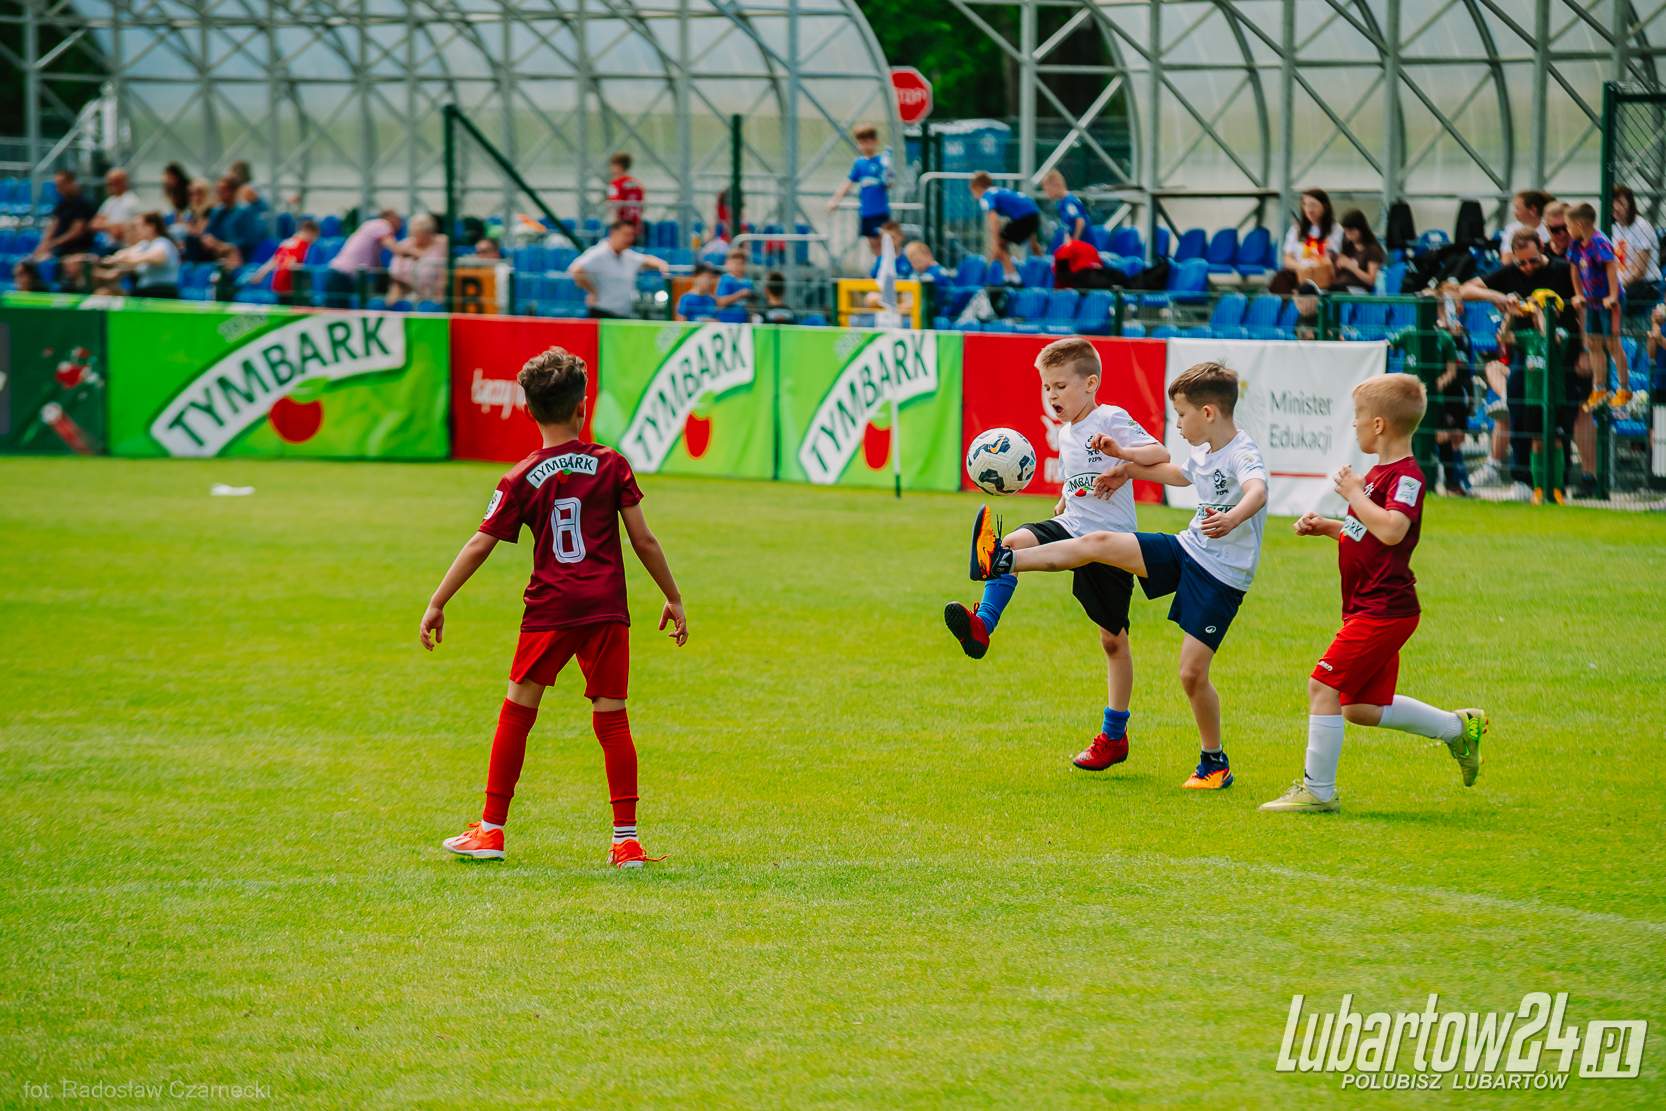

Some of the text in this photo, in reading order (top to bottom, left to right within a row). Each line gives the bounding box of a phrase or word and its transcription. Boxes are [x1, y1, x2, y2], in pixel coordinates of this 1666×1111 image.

[167, 316, 391, 447] TYMBARK
[633, 327, 747, 462] TYMBARK
[810, 333, 929, 473] TYMBARK
[1269, 390, 1333, 416] Minister
[530, 455, 594, 484] TYMBARK
[1269, 423, 1334, 456] Edukacji
[550, 497, 587, 564] 8
